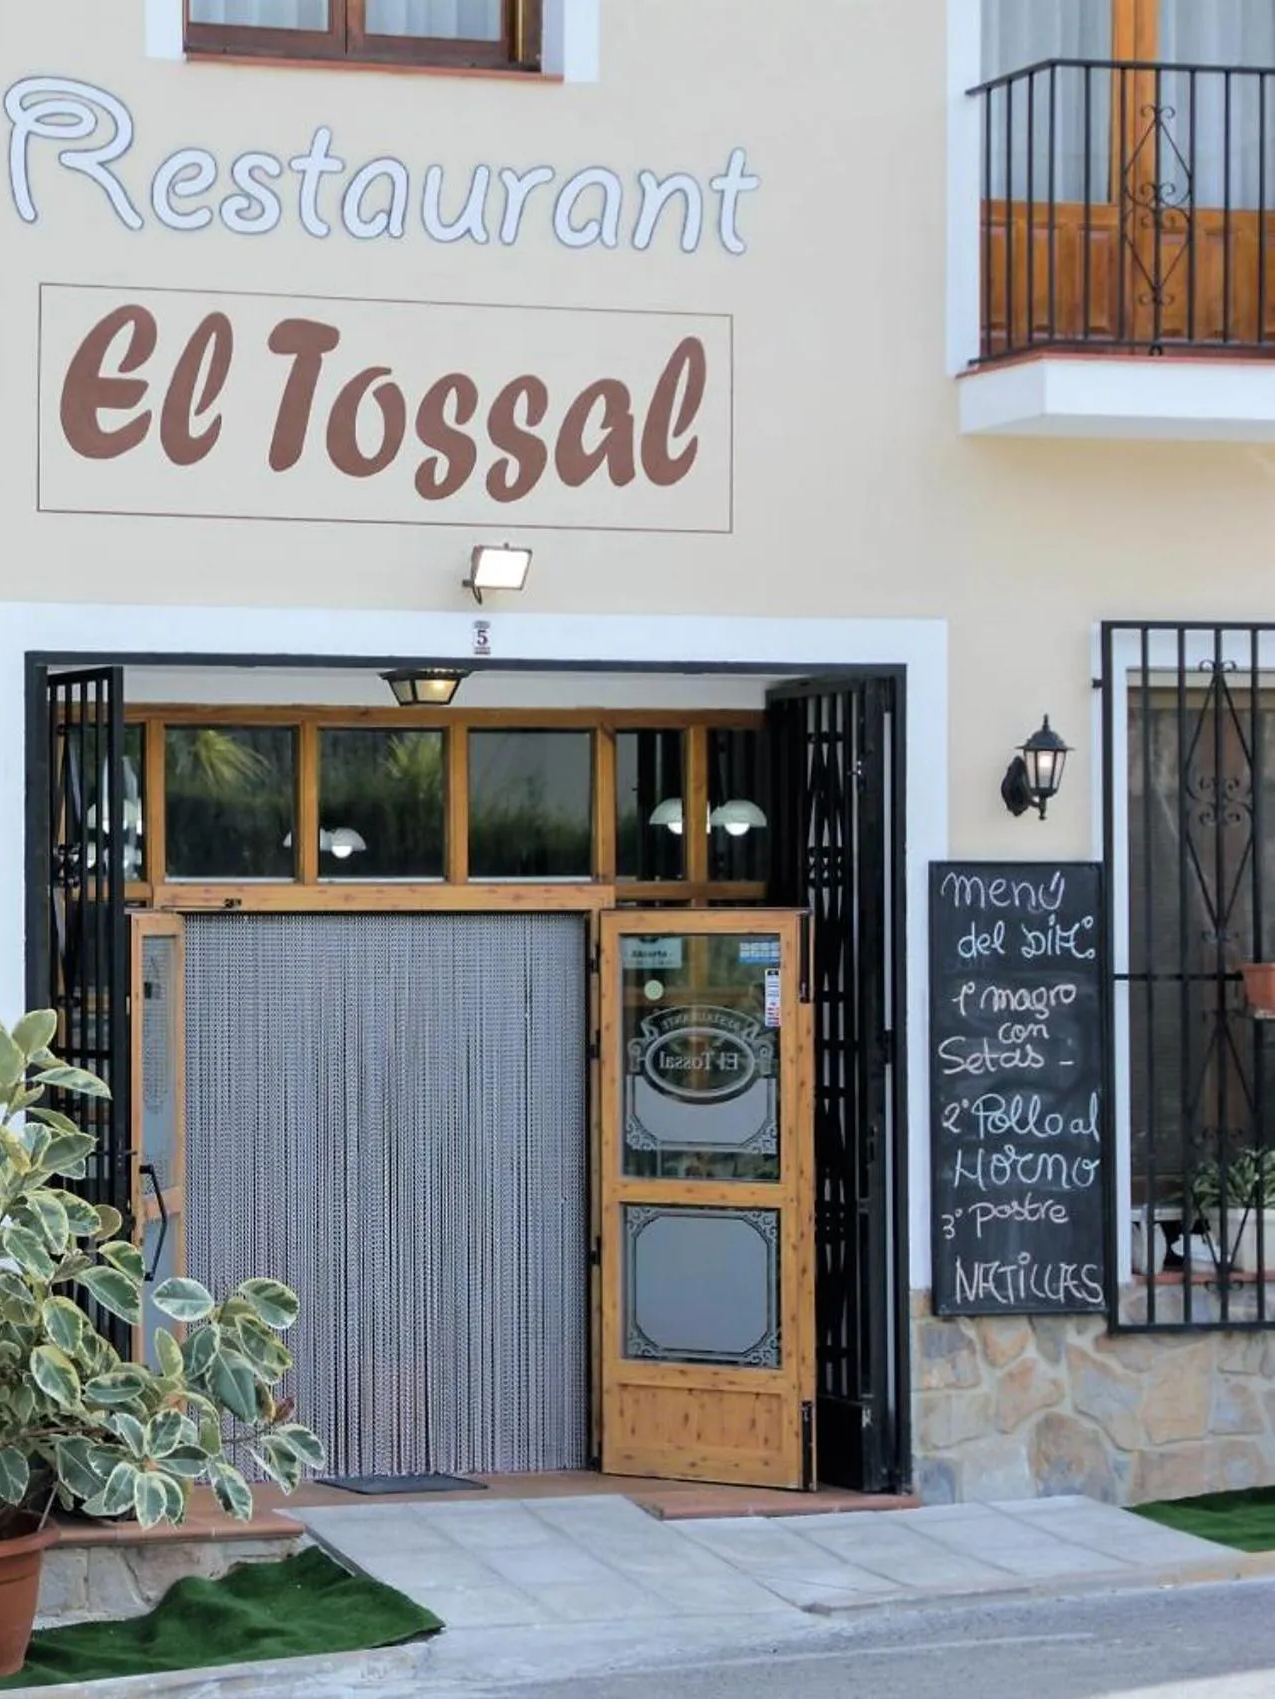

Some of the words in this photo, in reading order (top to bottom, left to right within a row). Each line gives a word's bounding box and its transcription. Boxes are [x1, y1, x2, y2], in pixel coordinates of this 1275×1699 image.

[3, 77, 761, 255] Restaurant
[60, 304, 234, 466] El
[267, 318, 707, 503] Tossal
[476, 629, 488, 647] 5
[957, 920, 1006, 959] del
[997, 1021, 1050, 1045] con
[938, 1035, 1046, 1075] Setas
[971, 1093, 1064, 1140] Pollo
[1069, 1091, 1101, 1142] al
